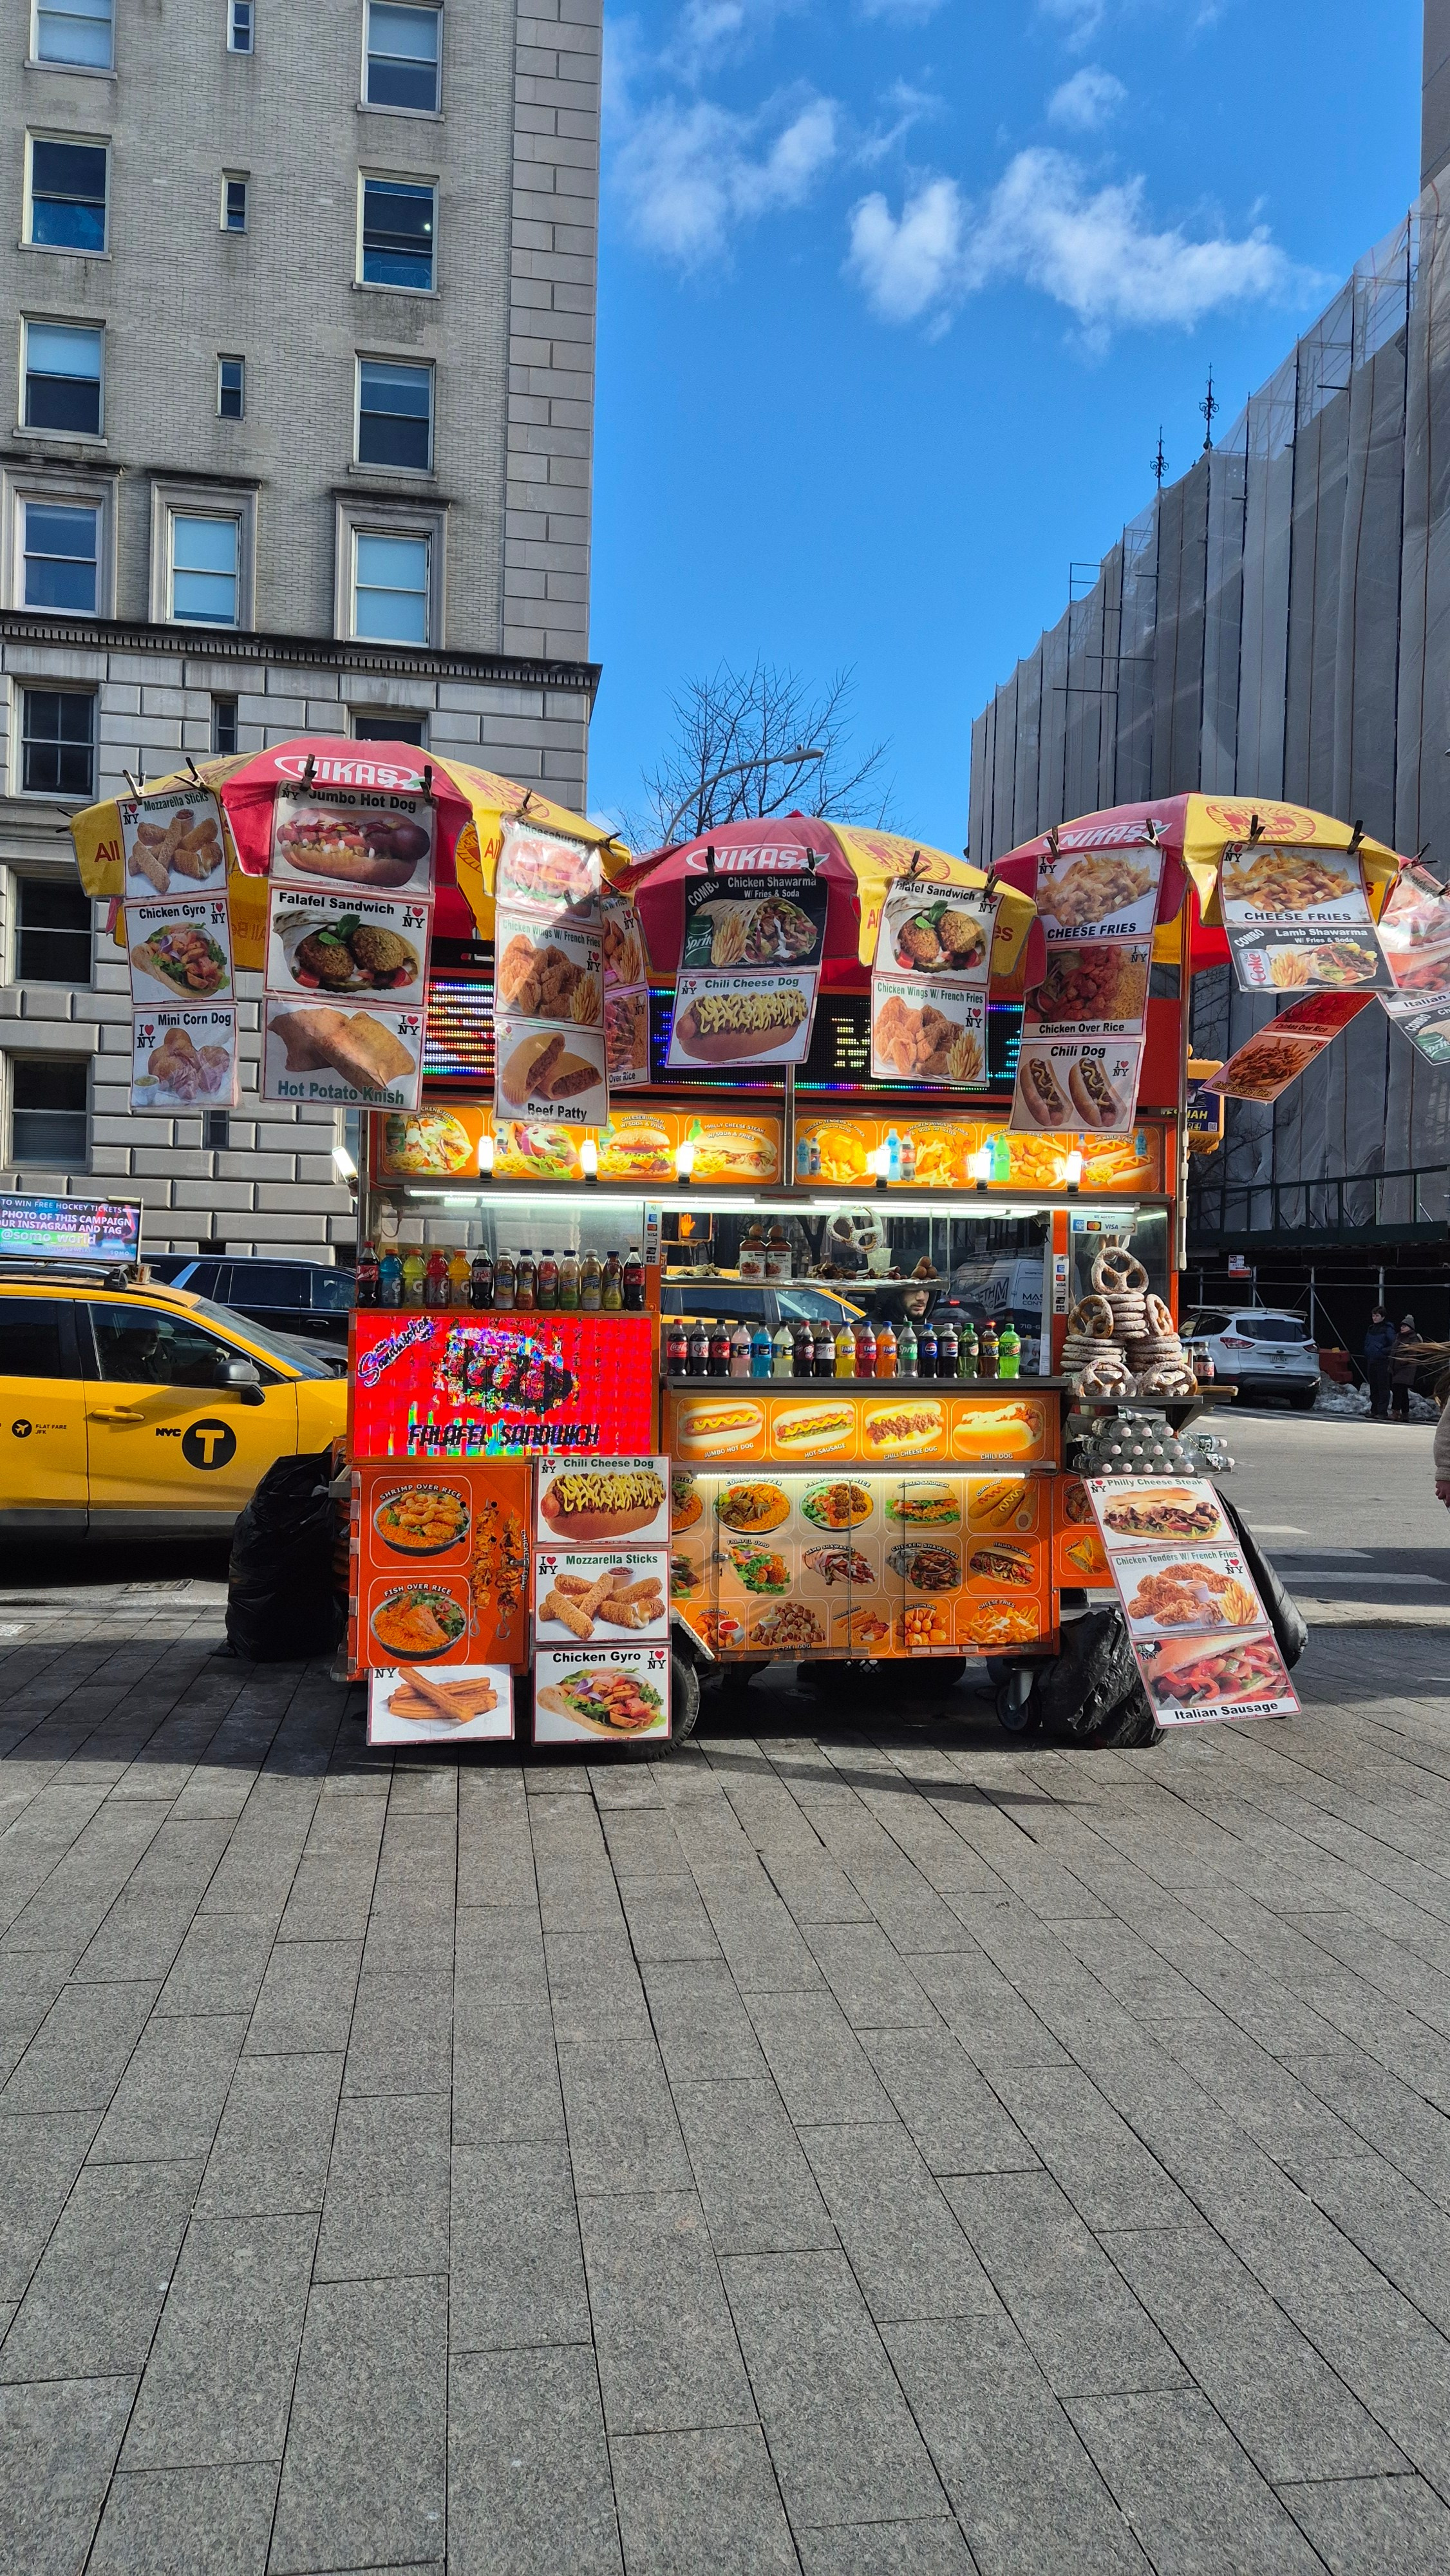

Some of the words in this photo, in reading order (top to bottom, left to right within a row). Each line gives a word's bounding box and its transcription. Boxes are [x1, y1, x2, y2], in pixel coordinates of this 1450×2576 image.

[144, 796, 184, 811] Mozzarella
[186, 792, 209, 804] Sticks
[308, 790, 355, 804] Jumbo
[361, 794, 385, 808] Hot
[390, 796, 417, 813] Dog
[518, 819, 588, 848] Cheeseburger
[94, 839, 120, 864] All
[728, 877, 764, 888] Chicken
[767, 876, 816, 887] Shawarma
[755, 889, 772, 898] Fries
[927, 885, 975, 900] Sandwich
[279, 892, 325, 907] Falafel
[330, 898, 394, 914] Sandwich
[140, 907, 180, 919] Chicken
[182, 904, 205, 918] Gyro
[1244, 912, 1304, 920] CHEESE
[502, 918, 531, 934] Chicken
[532, 923, 552, 938] Wings
[554, 929, 563, 940] W/
[564, 931, 585, 943] French
[586, 935, 601, 947] Fries
[1047, 926, 1096, 939] CHEESE
[1100, 923, 1136, 935] FRIES
[1234, 929, 1265, 947] COMBO
[1276, 929, 1306, 937] Lamb
[1248, 953, 1266, 983] Coke
[705, 980, 730, 989] Chili
[733, 978, 774, 988] Cheese
[778, 977, 799, 987] Dog
[878, 982, 905, 994] Chicken
[907, 986, 928, 999] Wings
[930, 989, 939, 999] W/
[941, 990, 965, 1001] French
[966, 993, 983, 1003] Fries
[1404, 994, 1447, 1008] Italian
[158, 1014, 180, 1026] Mini
[183, 1013, 207, 1025] Corn
[211, 1012, 231, 1027] Dog
[1405, 1014, 1431, 1032] COMBO
[1039, 1025, 1075, 1034] Chicken
[1078, 1023, 1100, 1033] Over
[1103, 1023, 1125, 1032] Rice
[1051, 1046, 1078, 1056] Chili
[1081, 1046, 1106, 1058] Dog
[609, 1073, 622, 1083] Over
[623, 1072, 636, 1081] Rice
[278, 1080, 305, 1096] Hot
[310, 1083, 358, 1100] Potato
[362, 1086, 404, 1104] Knish
[1212, 1081, 1229, 1090] Chili
[1228, 1085, 1254, 1095] Cheese
[1254, 1088, 1272, 1097] Fries
[527, 1103, 554, 1119] Beef
[558, 1104, 587, 1122] Patty
[621, 1115, 665, 1124] CHEESEBURGER
[747, 1124, 766, 1133] STEAK
[90, 1205, 122, 1213] TICKETS
[2, 1210, 37, 1220] PHOTO
[55, 1214, 77, 1222] THIS
[79, 1215, 132, 1226] CAMPAIGN
[17, 1220, 77, 1231] INSTAGRAM
[103, 1226, 122, 1235] TAG
[1, 1228, 96, 1244] @somo_world
[155, 1428, 182, 1437] NYC
[408, 1425, 487, 1446] FALAFEL
[500, 1425, 600, 1447] SANDWICH
[195, 1429, 225, 1463] T
[704, 1448, 726, 1458] JUMBO
[805, 1450, 816, 1459] HOT
[818, 1443, 846, 1454] SAUSAGE
[900, 1448, 923, 1457] CHEESE
[591, 1459, 630, 1467] Cheese
[634, 1459, 654, 1469] Dog
[897, 1481, 920, 1489] CHICKEN
[921, 1480, 950, 1488] SANDWICH
[976, 1485, 988, 1497] CORN
[989, 1479, 1002, 1489] DOG
[379, 1484, 413, 1501] SHRIMP
[442, 1487, 462, 1499] RICE
[805, 1547, 821, 1555] LAMB
[822, 1544, 856, 1553] SHAWARMA
[891, 1542, 921, 1552] CHICKEN
[923, 1542, 959, 1560] SHAWARMA
[1011, 1546, 1031, 1558] SAUSAGE
[566, 1555, 622, 1564] Mozzarella
[626, 1554, 658, 1563] Sticks
[1116, 1557, 1147, 1566] Chicken
[1149, 1554, 1178, 1564] Tenders
[1191, 1552, 1218, 1560] French
[384, 1586, 404, 1597] FISH
[432, 1585, 452, 1595] RICE
[977, 1600, 999, 1610] CHEESE
[999, 1600, 1016, 1609] FRIES
[552, 1651, 606, 1663] Chicken
[610, 1651, 641, 1663] Gyro
[1174, 1709, 1218, 1720] Italian
[1221, 1702, 1278, 1716] Sausage
